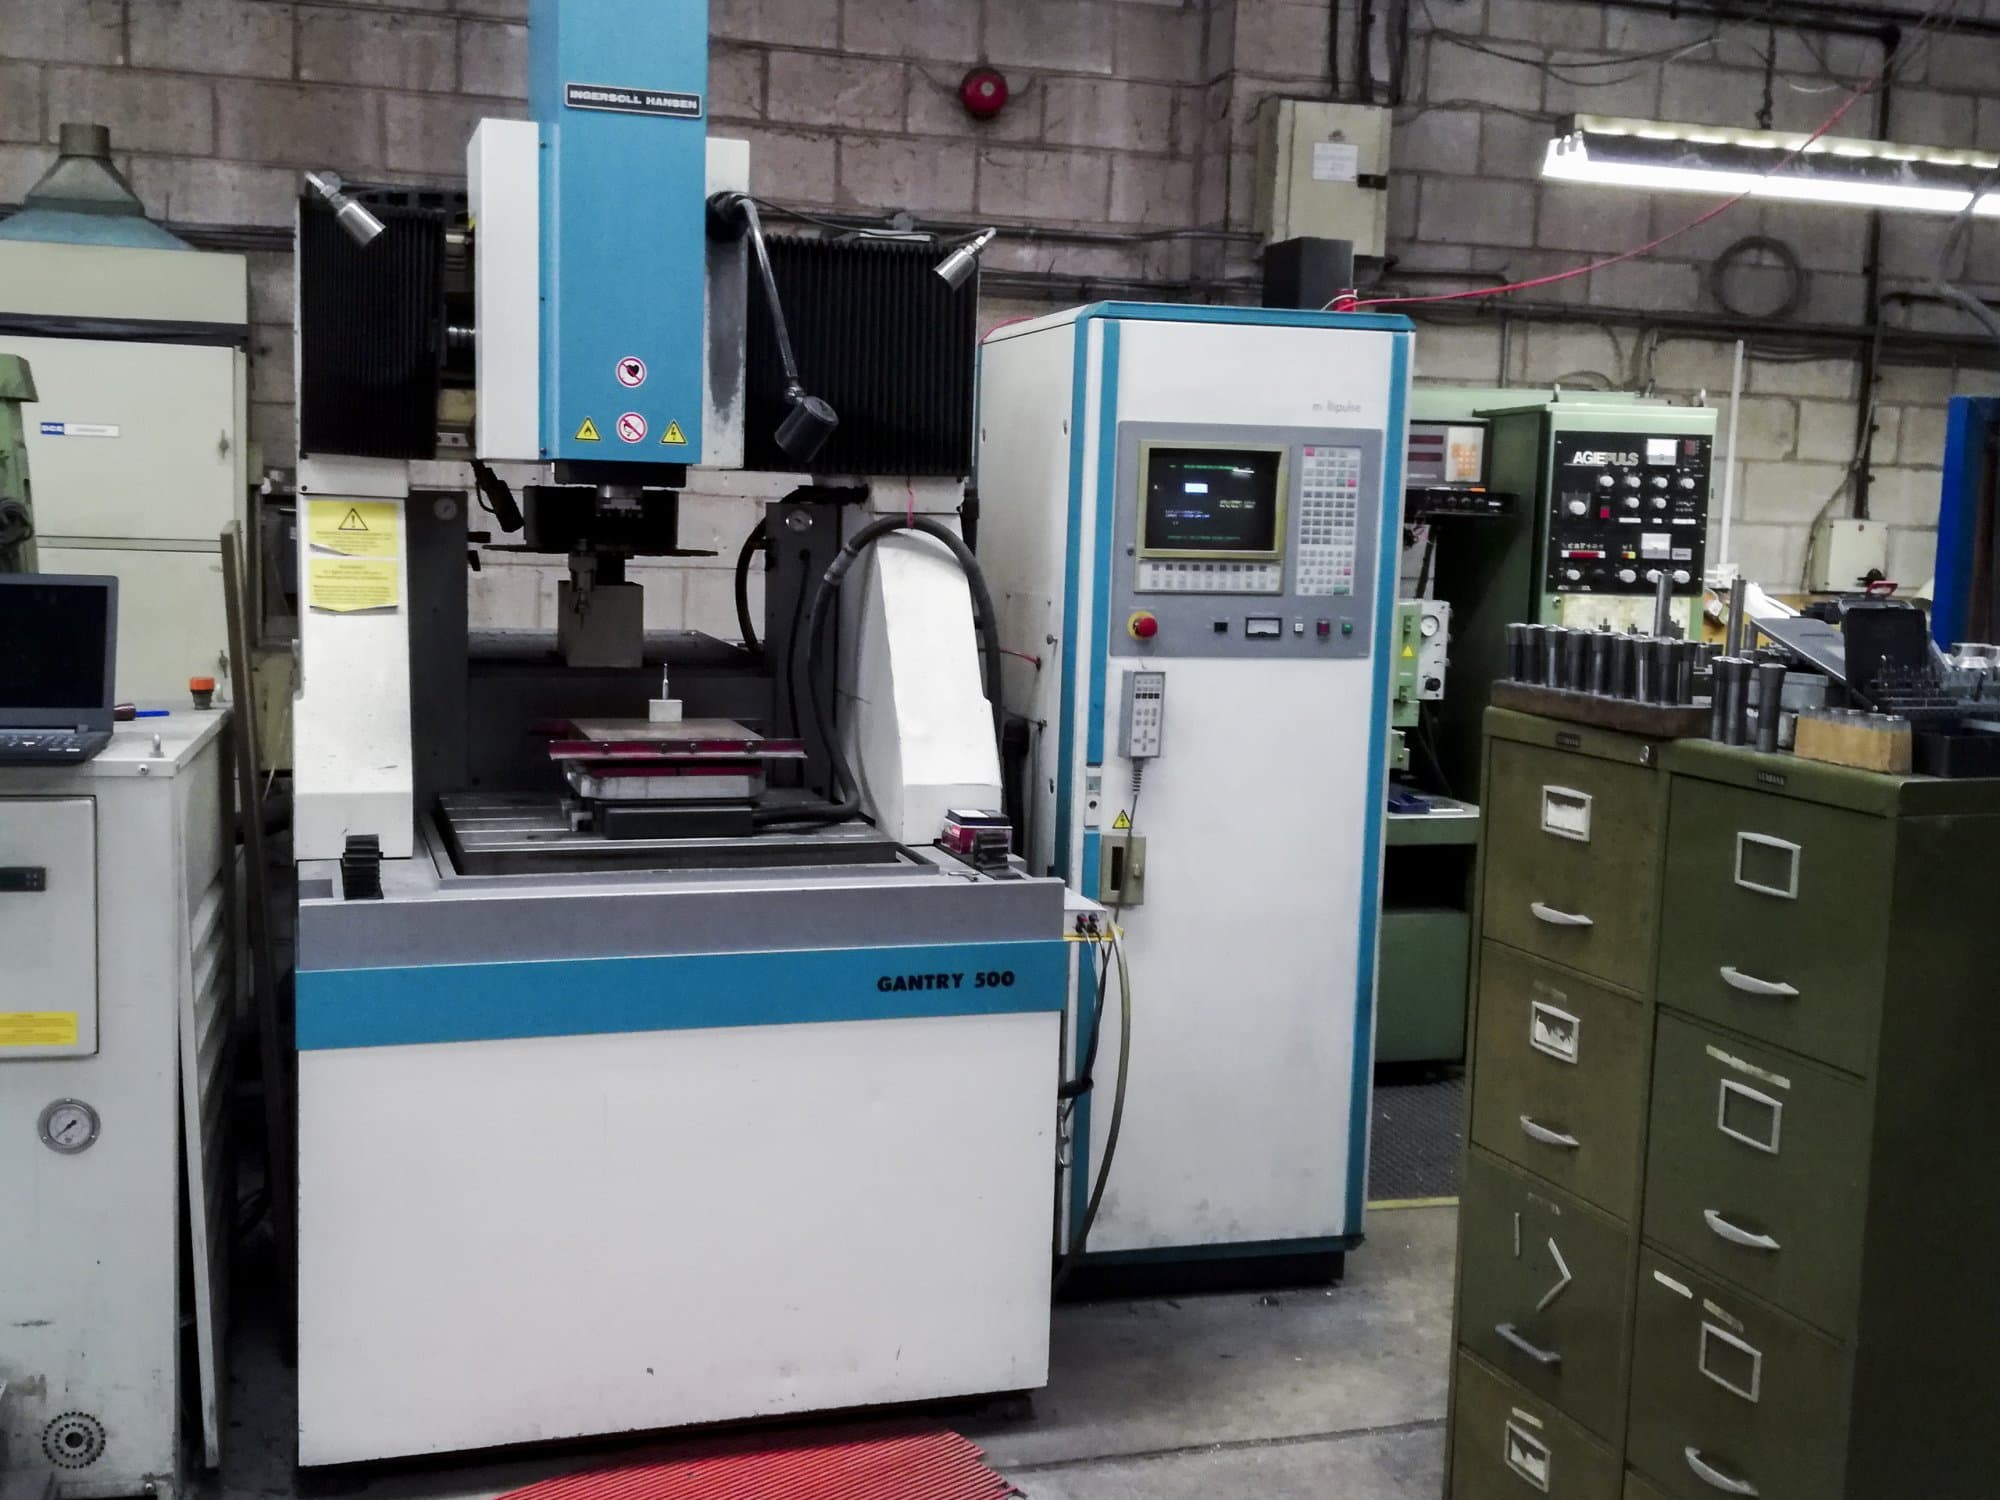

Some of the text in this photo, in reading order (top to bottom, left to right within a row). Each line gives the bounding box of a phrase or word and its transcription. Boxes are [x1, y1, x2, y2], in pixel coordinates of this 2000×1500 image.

[569, 90, 698, 109] INGERSOLL HANSEN
[1572, 450, 1639, 466] AGIEPULS
[877, 970, 1016, 992] GANTRY 500
